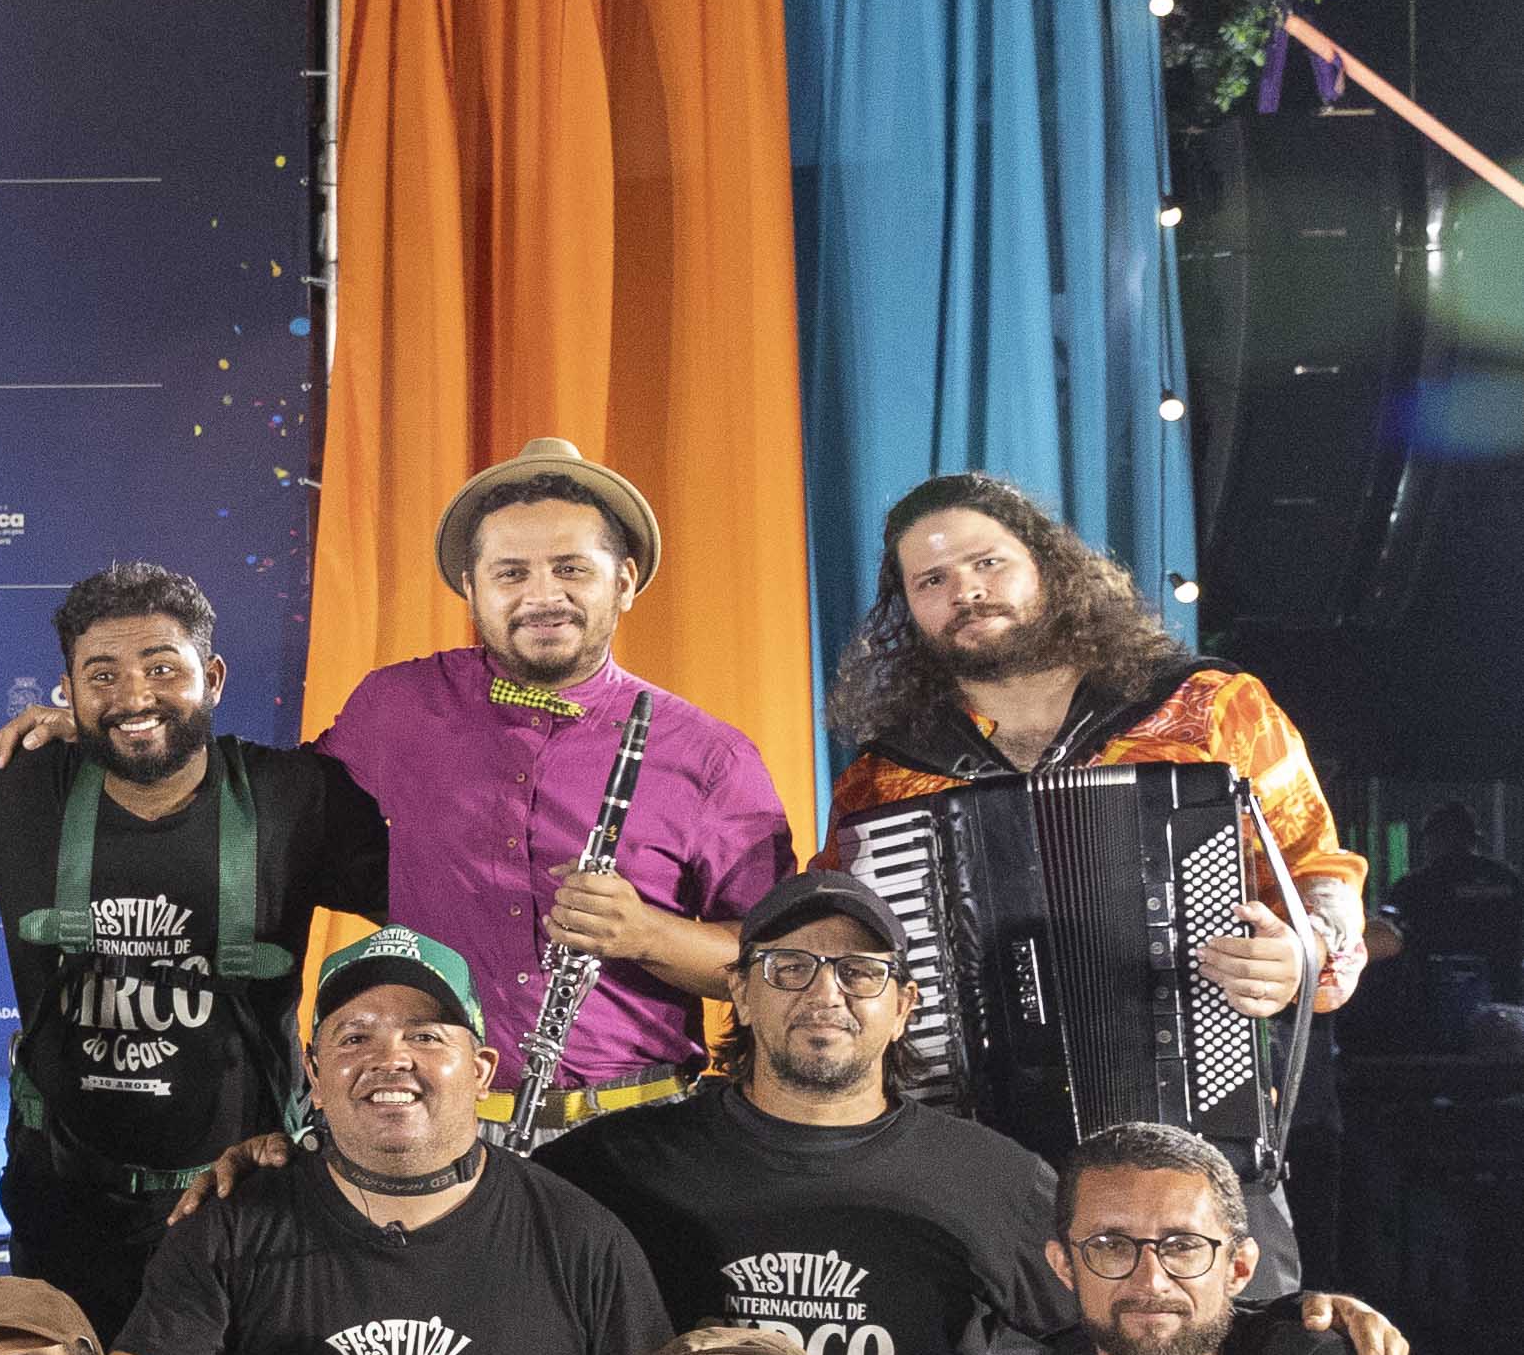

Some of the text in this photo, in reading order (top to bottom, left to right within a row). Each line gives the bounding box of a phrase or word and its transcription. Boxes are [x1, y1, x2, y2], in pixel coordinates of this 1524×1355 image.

[91, 894, 194, 937] ESTIVAL
[174, 939, 192, 955] DE
[82, 1033, 179, 1072] do Ceará
[721, 1250, 870, 1298] FESTIVAL
[847, 1302, 867, 1320] DE
